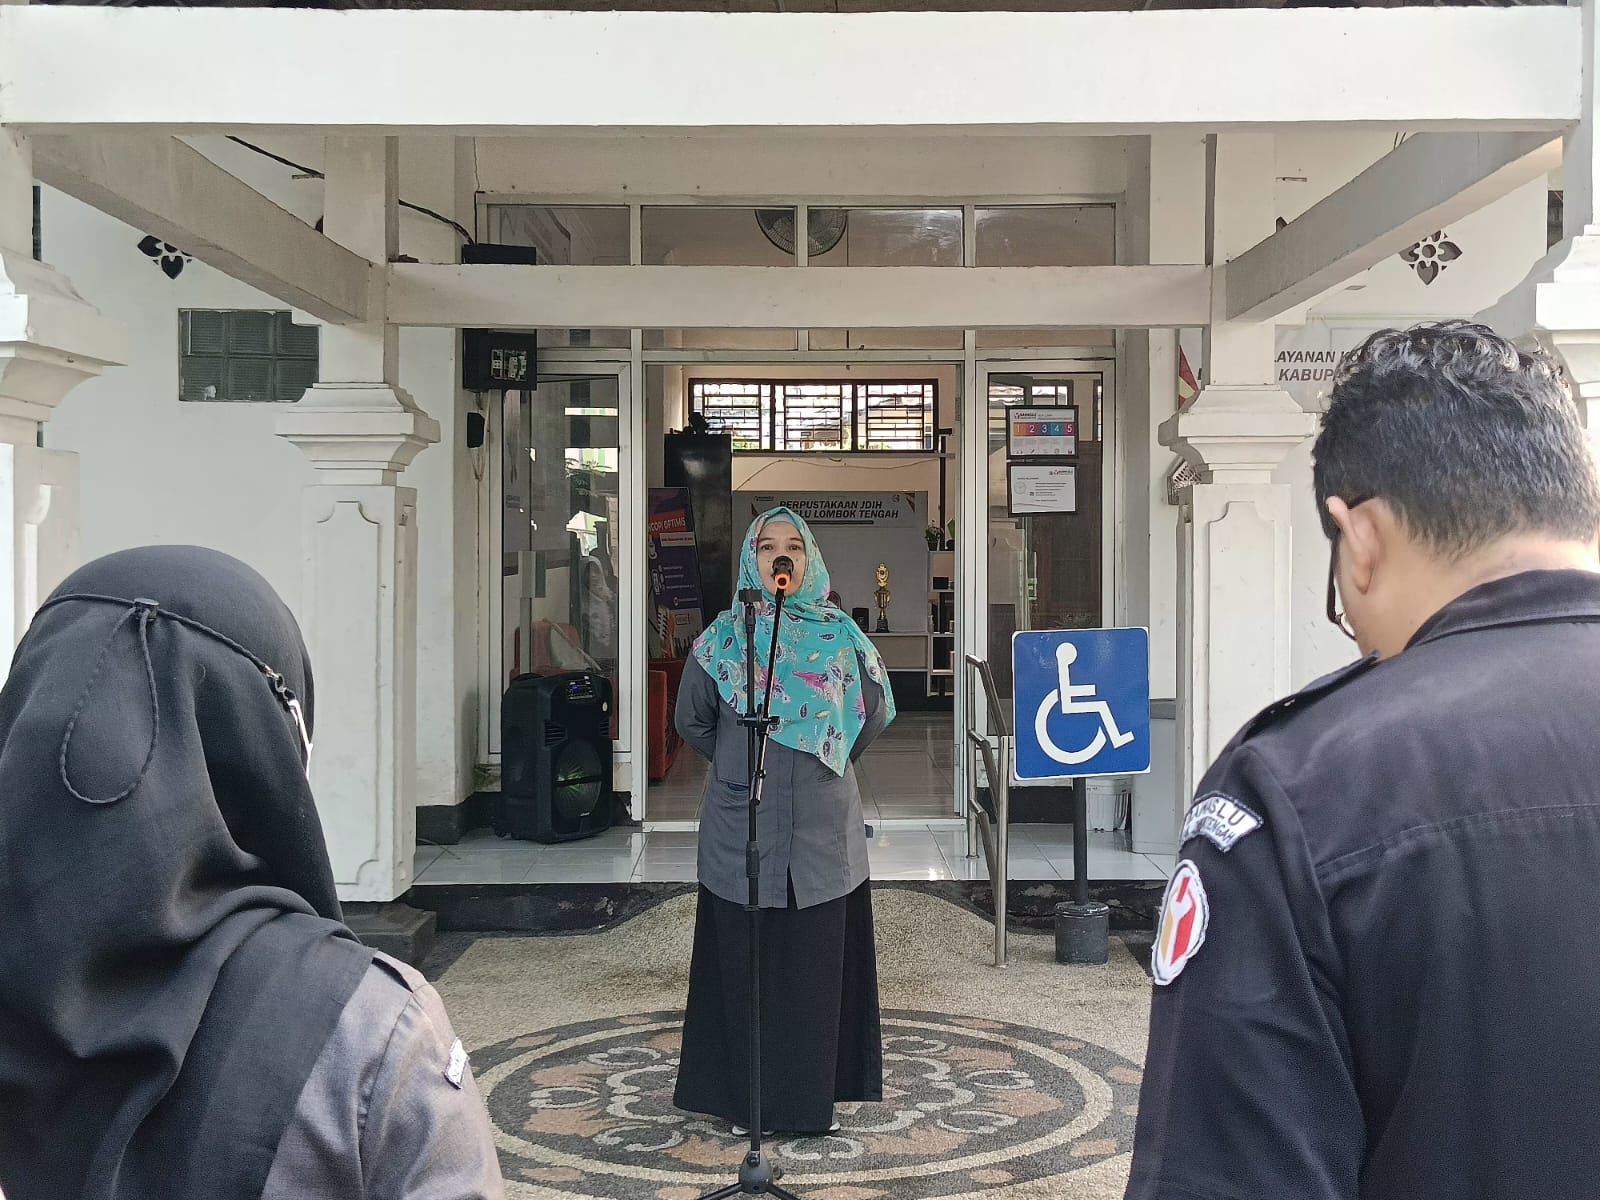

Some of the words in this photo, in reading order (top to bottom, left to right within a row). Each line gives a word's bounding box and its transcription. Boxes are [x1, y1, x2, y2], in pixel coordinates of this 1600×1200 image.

[1274, 350, 1336, 363] AYANAN
[1029, 424, 1035, 433] 2
[1041, 424, 1048, 433] 3
[1067, 424, 1073, 433] 5
[779, 500, 858, 509] PERPUSTAKAAN
[859, 500, 882, 509] JDIH
[813, 510, 856, 518] LOMBOK
[859, 510, 899, 519] TENGAH
